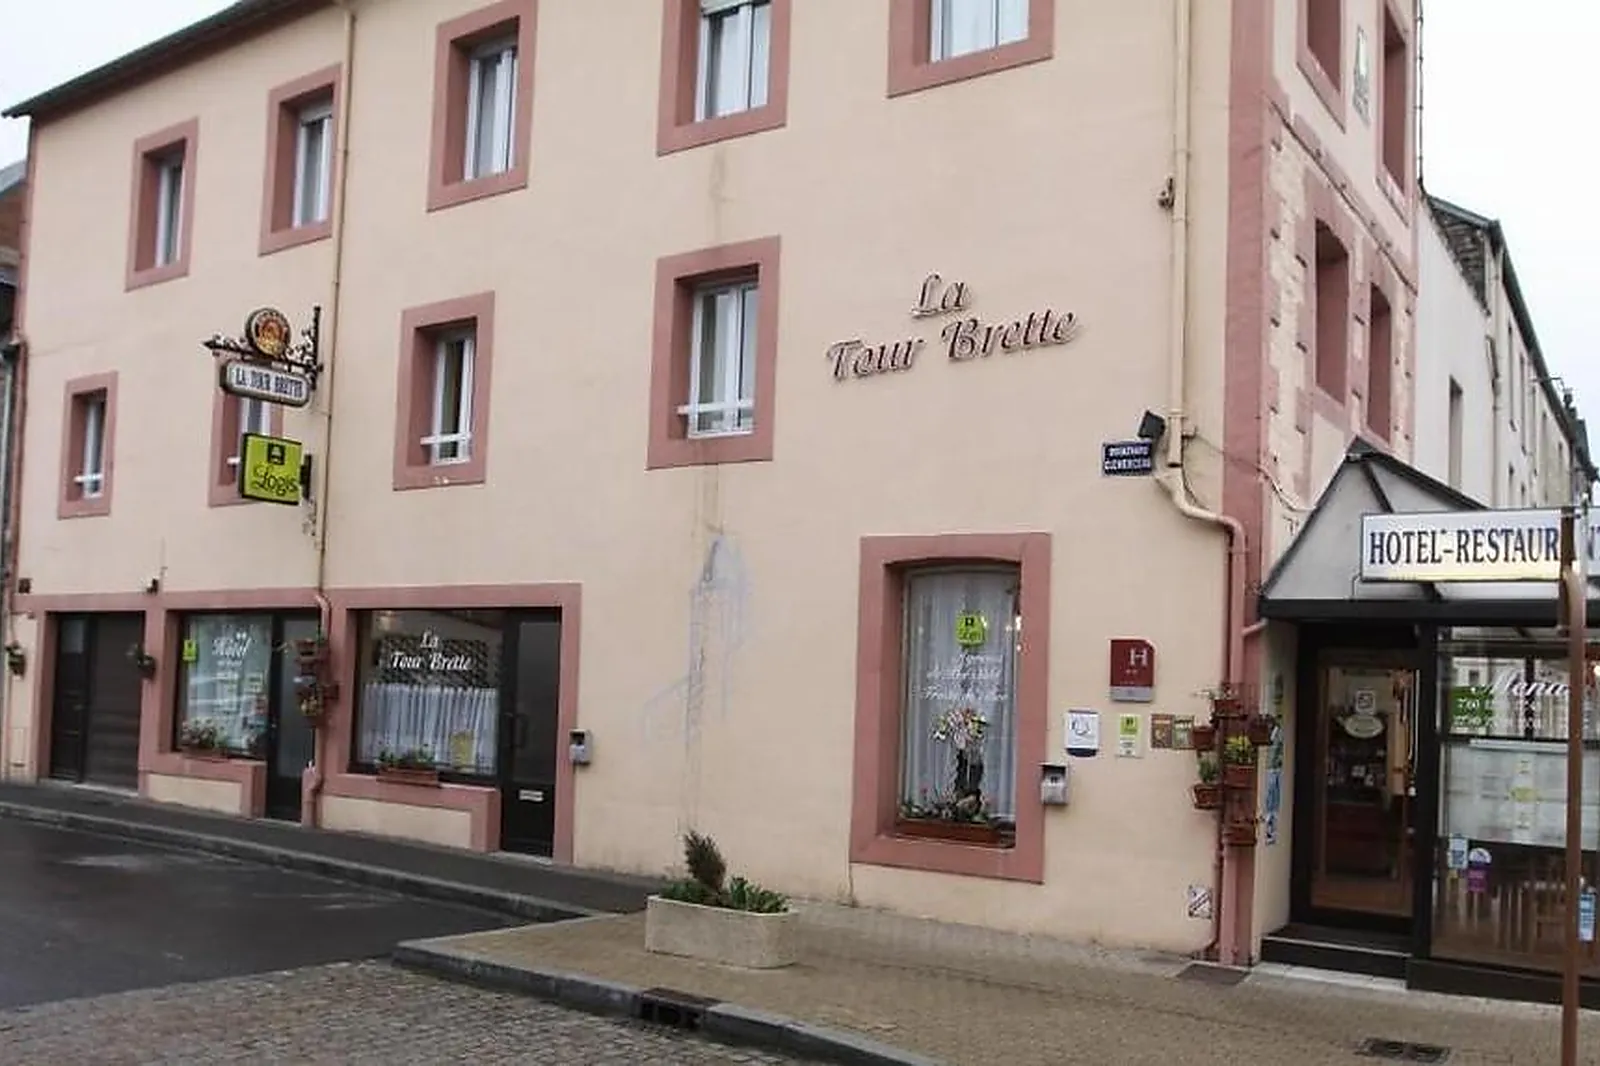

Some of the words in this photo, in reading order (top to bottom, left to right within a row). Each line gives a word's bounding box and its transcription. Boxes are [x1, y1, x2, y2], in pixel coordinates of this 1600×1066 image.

[911, 273, 971, 317] La
[825, 336, 925, 380] Tour
[940, 309, 1079, 361] Brette
[252, 464, 299, 496] Logis
